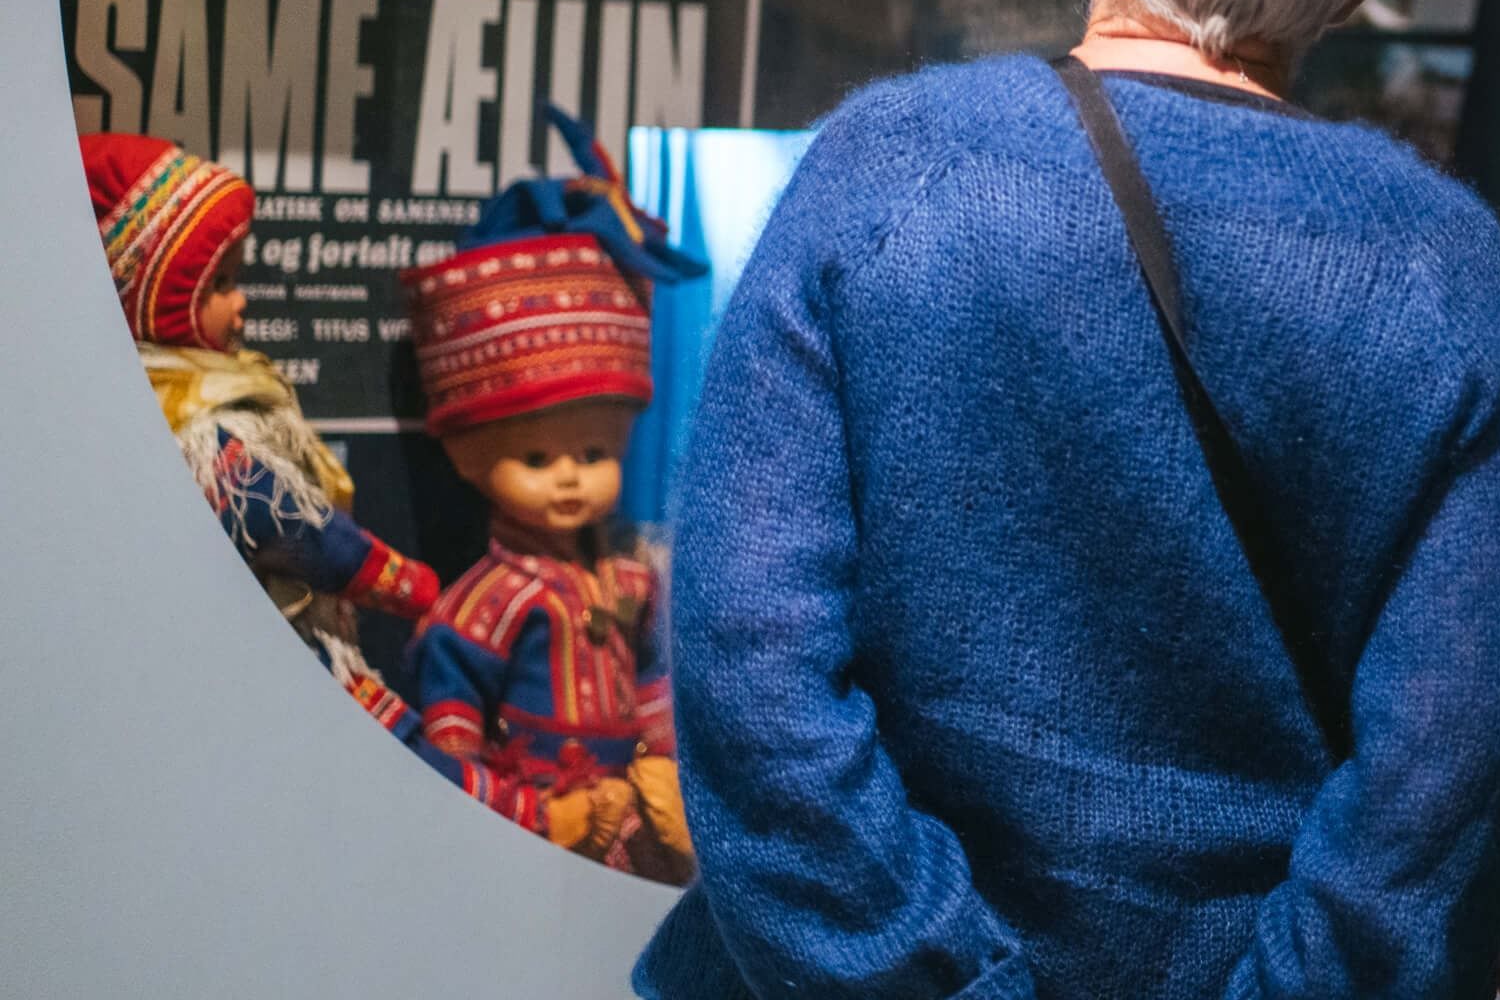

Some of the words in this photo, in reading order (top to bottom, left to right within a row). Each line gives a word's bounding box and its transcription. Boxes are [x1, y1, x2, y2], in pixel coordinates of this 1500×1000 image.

[334, 198, 370, 223] OM
[261, 238, 302, 274] og
[307, 231, 413, 274] fortalt
[311, 318, 371, 343] TITUS
